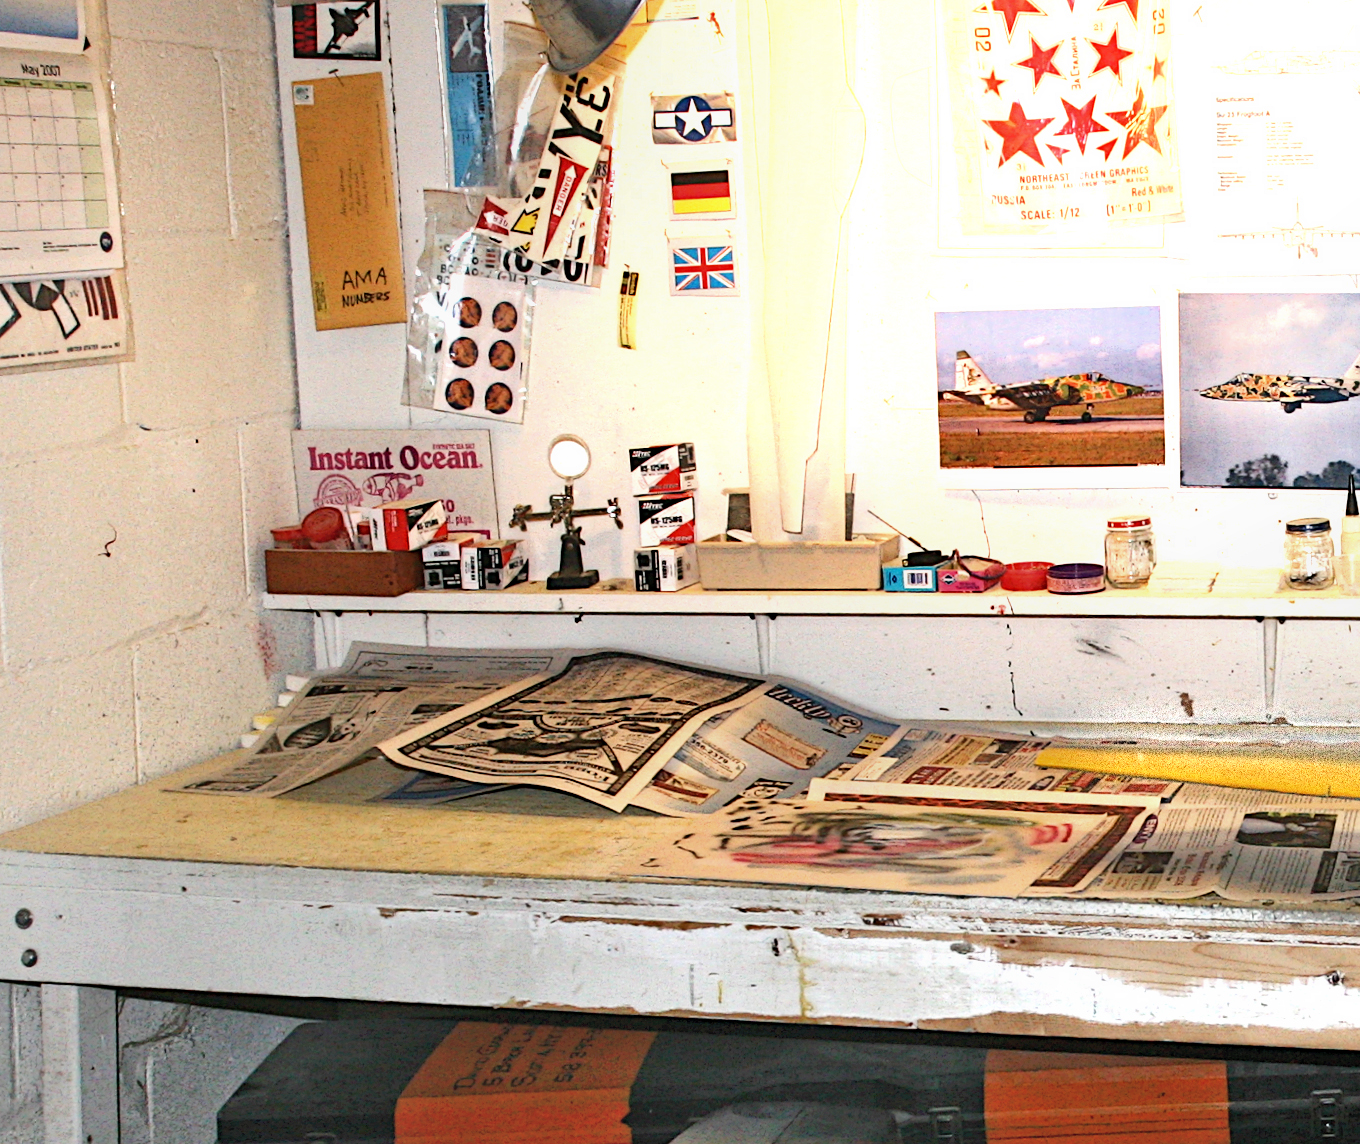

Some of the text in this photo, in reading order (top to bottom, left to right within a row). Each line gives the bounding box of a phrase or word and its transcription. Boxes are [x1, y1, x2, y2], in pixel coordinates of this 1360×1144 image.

[21, 63, 61, 78] May 2007
[1019, 172, 1070, 184] NORTHEAST
[1109, 166, 1149, 178] GRAPHICS
[554, 176, 572, 212] DANGER
[1131, 186, 1147, 198] Red
[1059, 207, 1080, 220] 1/12
[342, 267, 388, 291] AMA
[342, 291, 390, 308] NUMBERS
[307, 446, 394, 471] Instant
